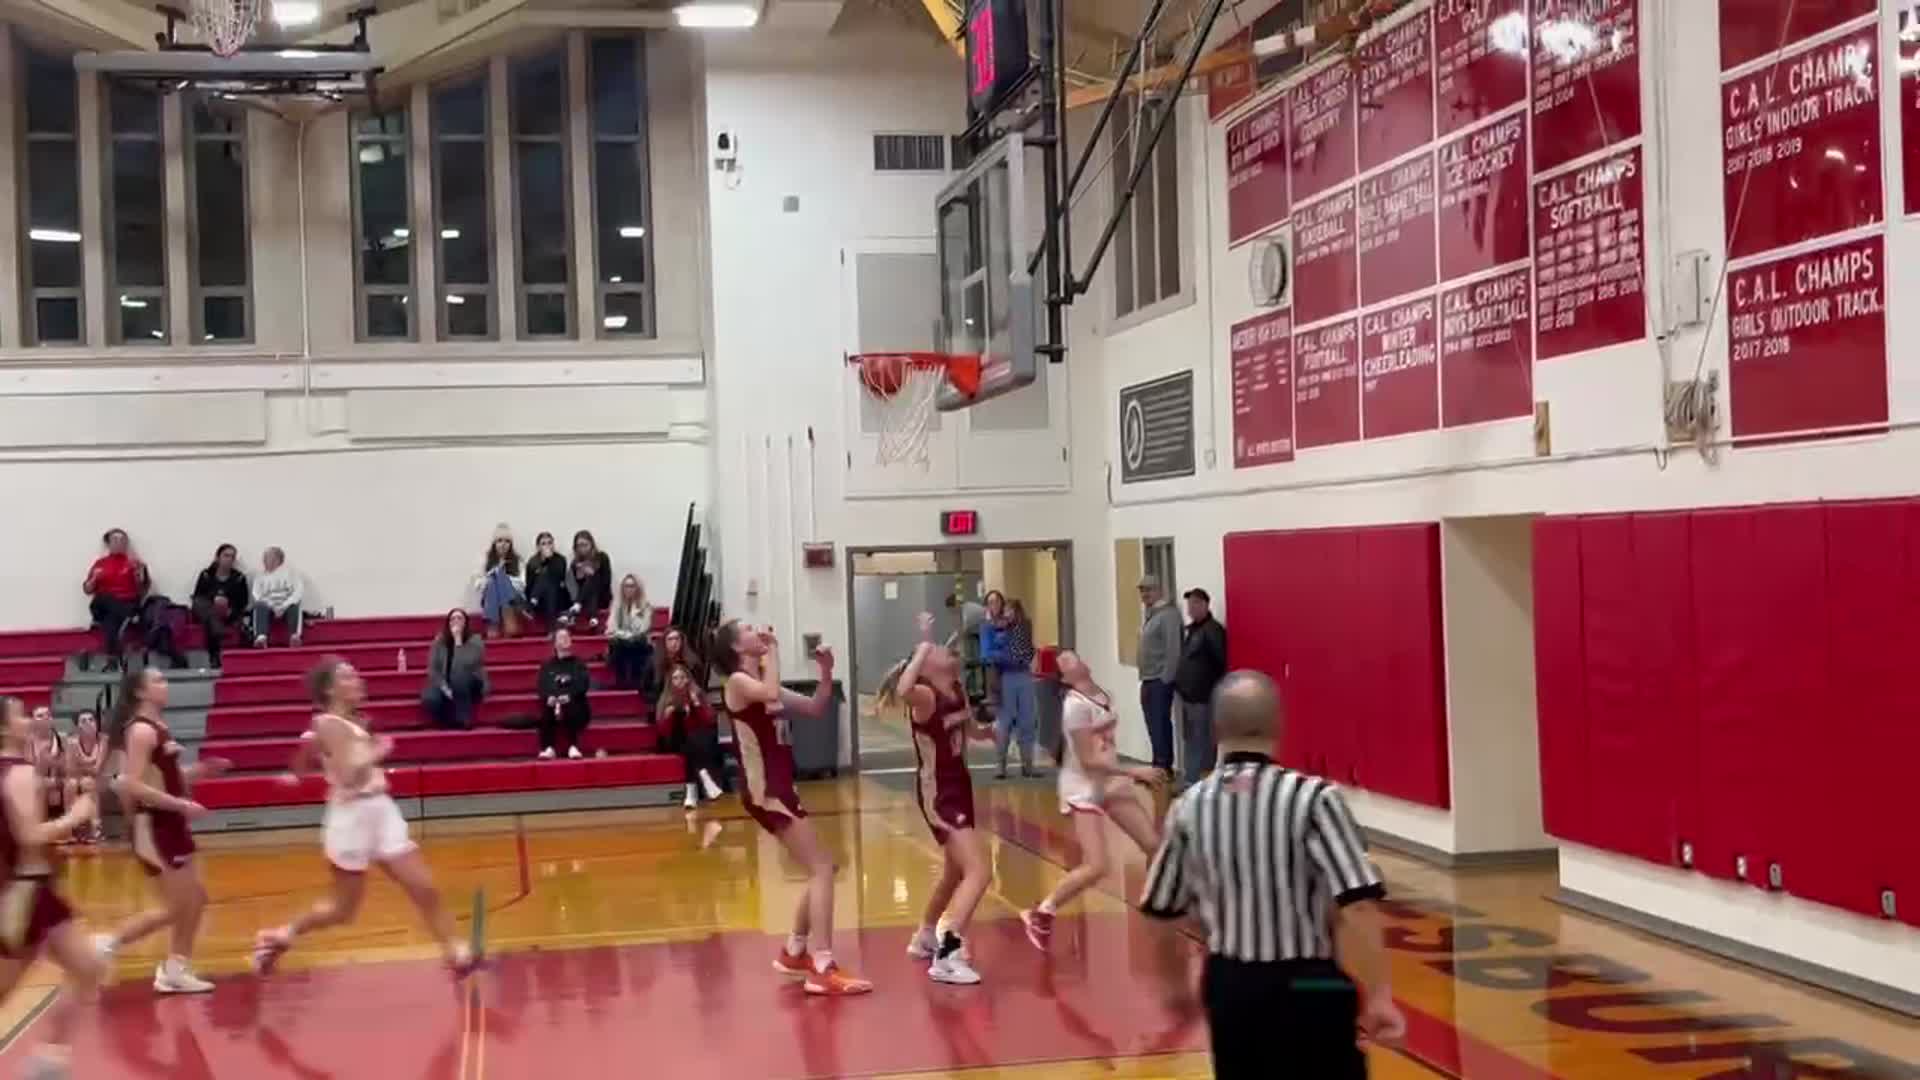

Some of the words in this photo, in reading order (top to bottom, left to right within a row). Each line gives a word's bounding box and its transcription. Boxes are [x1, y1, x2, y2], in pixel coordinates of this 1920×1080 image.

[1472, 115, 1521, 155] CHAMPS
[1726, 116, 1764, 150] GIRLS
[1767, 95, 1820, 136] INDOOR
[1467, 142, 1516, 181] HOCKEY
[1576, 153, 1636, 195] CHAMPS
[1550, 185, 1623, 229] SOFTBALL
[1475, 275, 1527, 307] CHAMPS
[1735, 270, 1788, 308] C.A.L.
[1795, 247, 1874, 295] CHAMPS
[1392, 300, 1433, 330] CHAMPS
[1732, 311, 1766, 338] GIRLS
[1770, 299, 1831, 332] OUTDOOR
[1733, 339, 1761, 361] 2017
[1763, 335, 1790, 358] 2018
